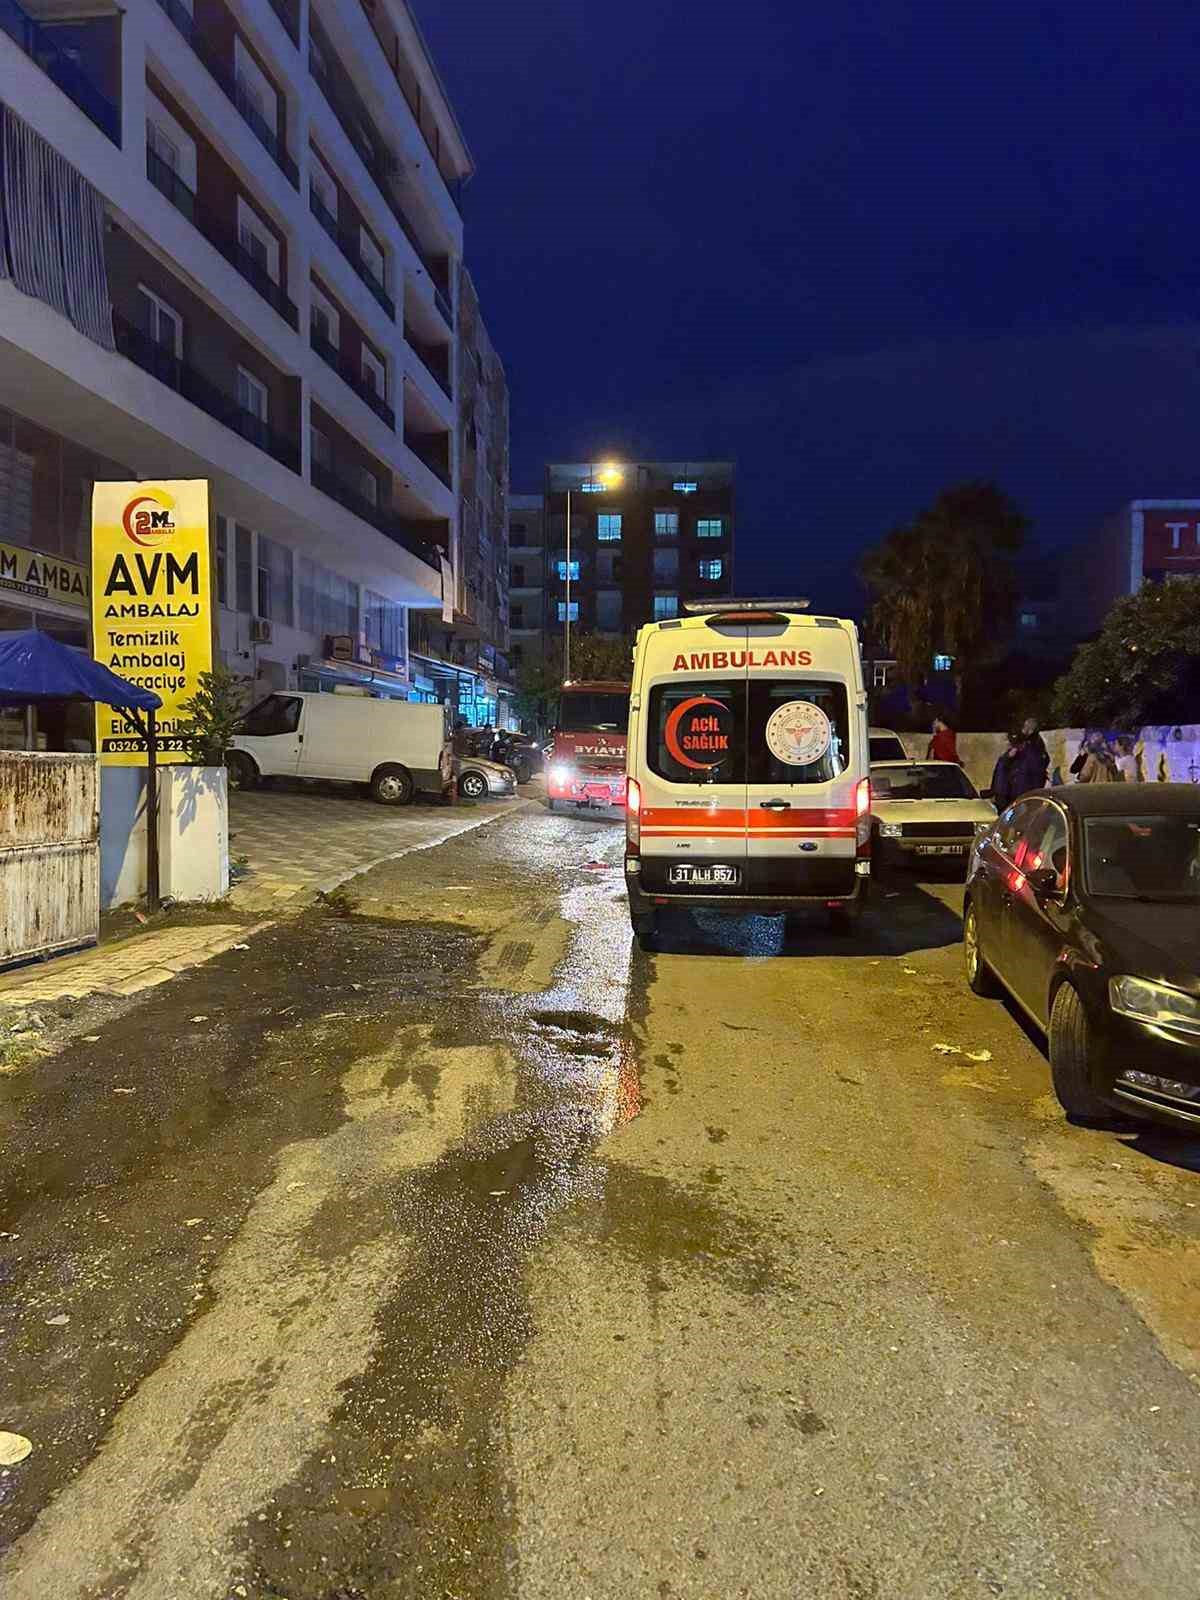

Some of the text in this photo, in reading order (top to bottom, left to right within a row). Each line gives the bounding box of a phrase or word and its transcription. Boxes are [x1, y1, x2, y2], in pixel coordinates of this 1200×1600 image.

[104, 552, 199, 596] AVM
[104, 603, 199, 618] AMBALAJ
[107, 631, 179, 646] Temizlik
[108, 651, 185, 671] Ambalaj
[672, 650, 812, 671] AMBULANS
[690, 714, 720, 732] ACİL
[109, 741, 139, 751] 0326
[142, 741, 165, 751] 73
[168, 740, 183, 750] 22
[682, 733, 729, 749] SAĞLIK
[676, 869, 732, 881] 31 ALH 857
